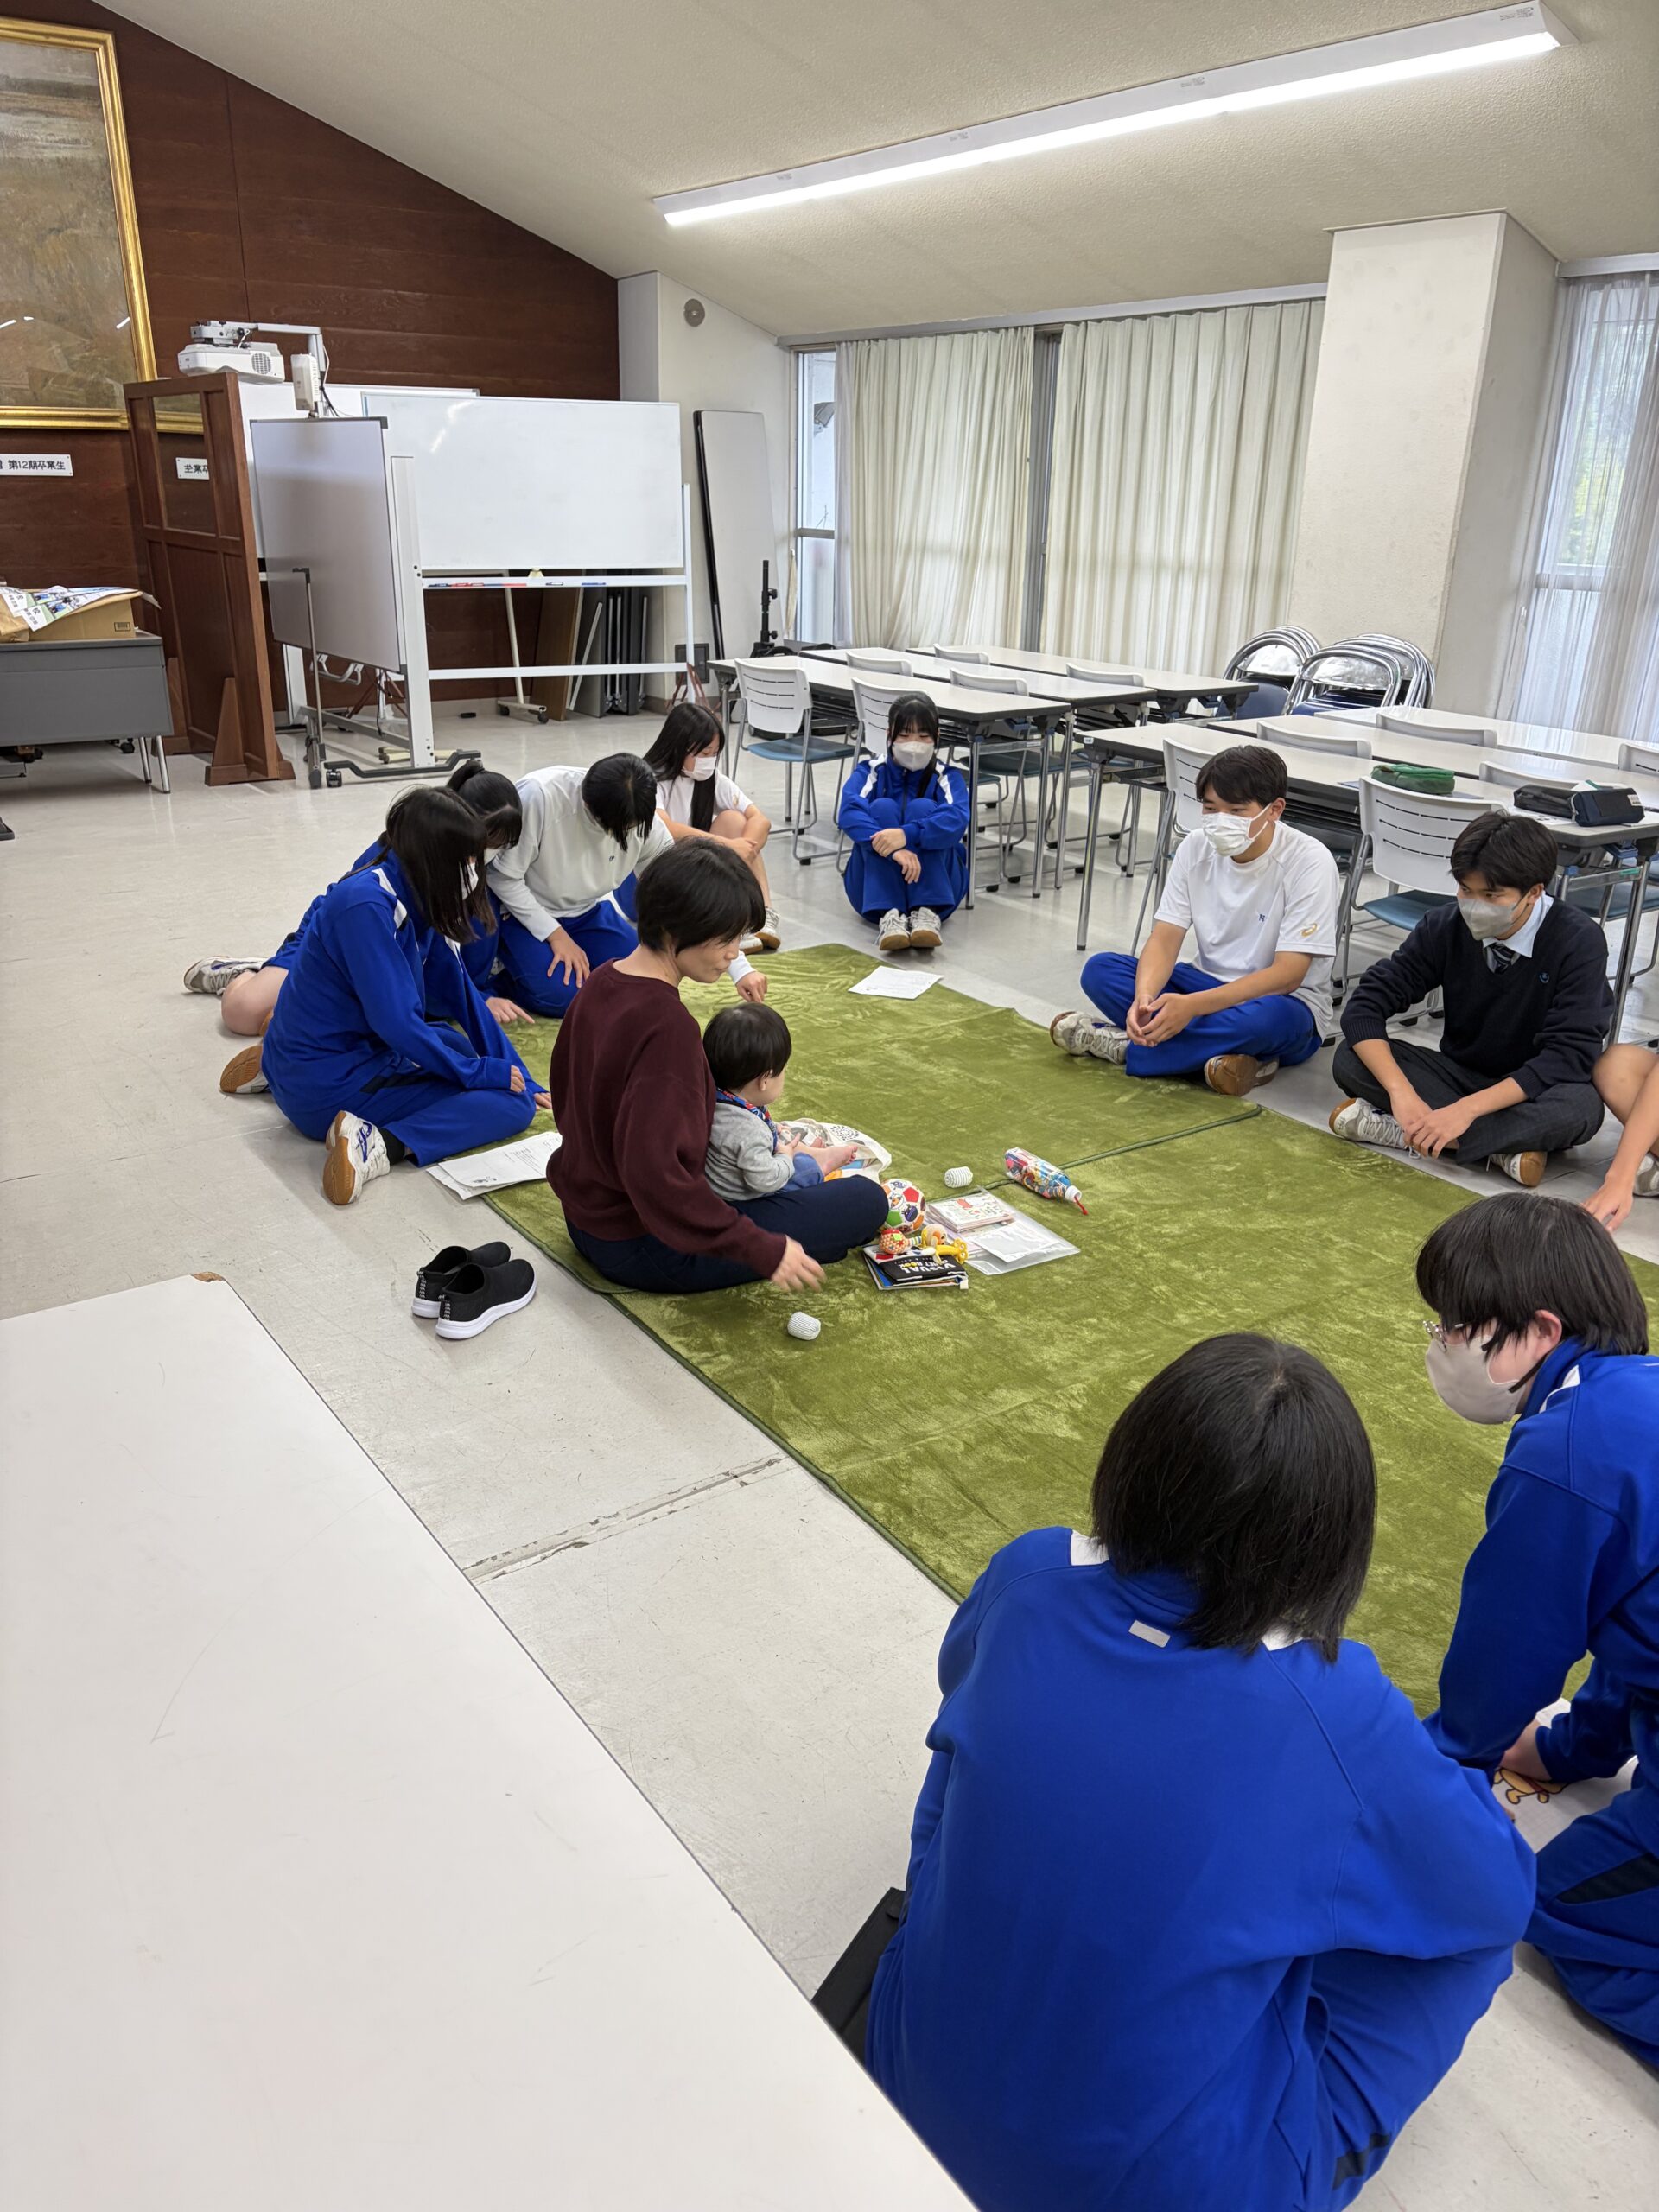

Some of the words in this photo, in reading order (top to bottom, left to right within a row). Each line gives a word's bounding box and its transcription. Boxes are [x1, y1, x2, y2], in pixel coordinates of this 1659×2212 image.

[8, 459, 66, 470] 第12期卒業生
[901, 1263, 956, 1274] VISUAL
